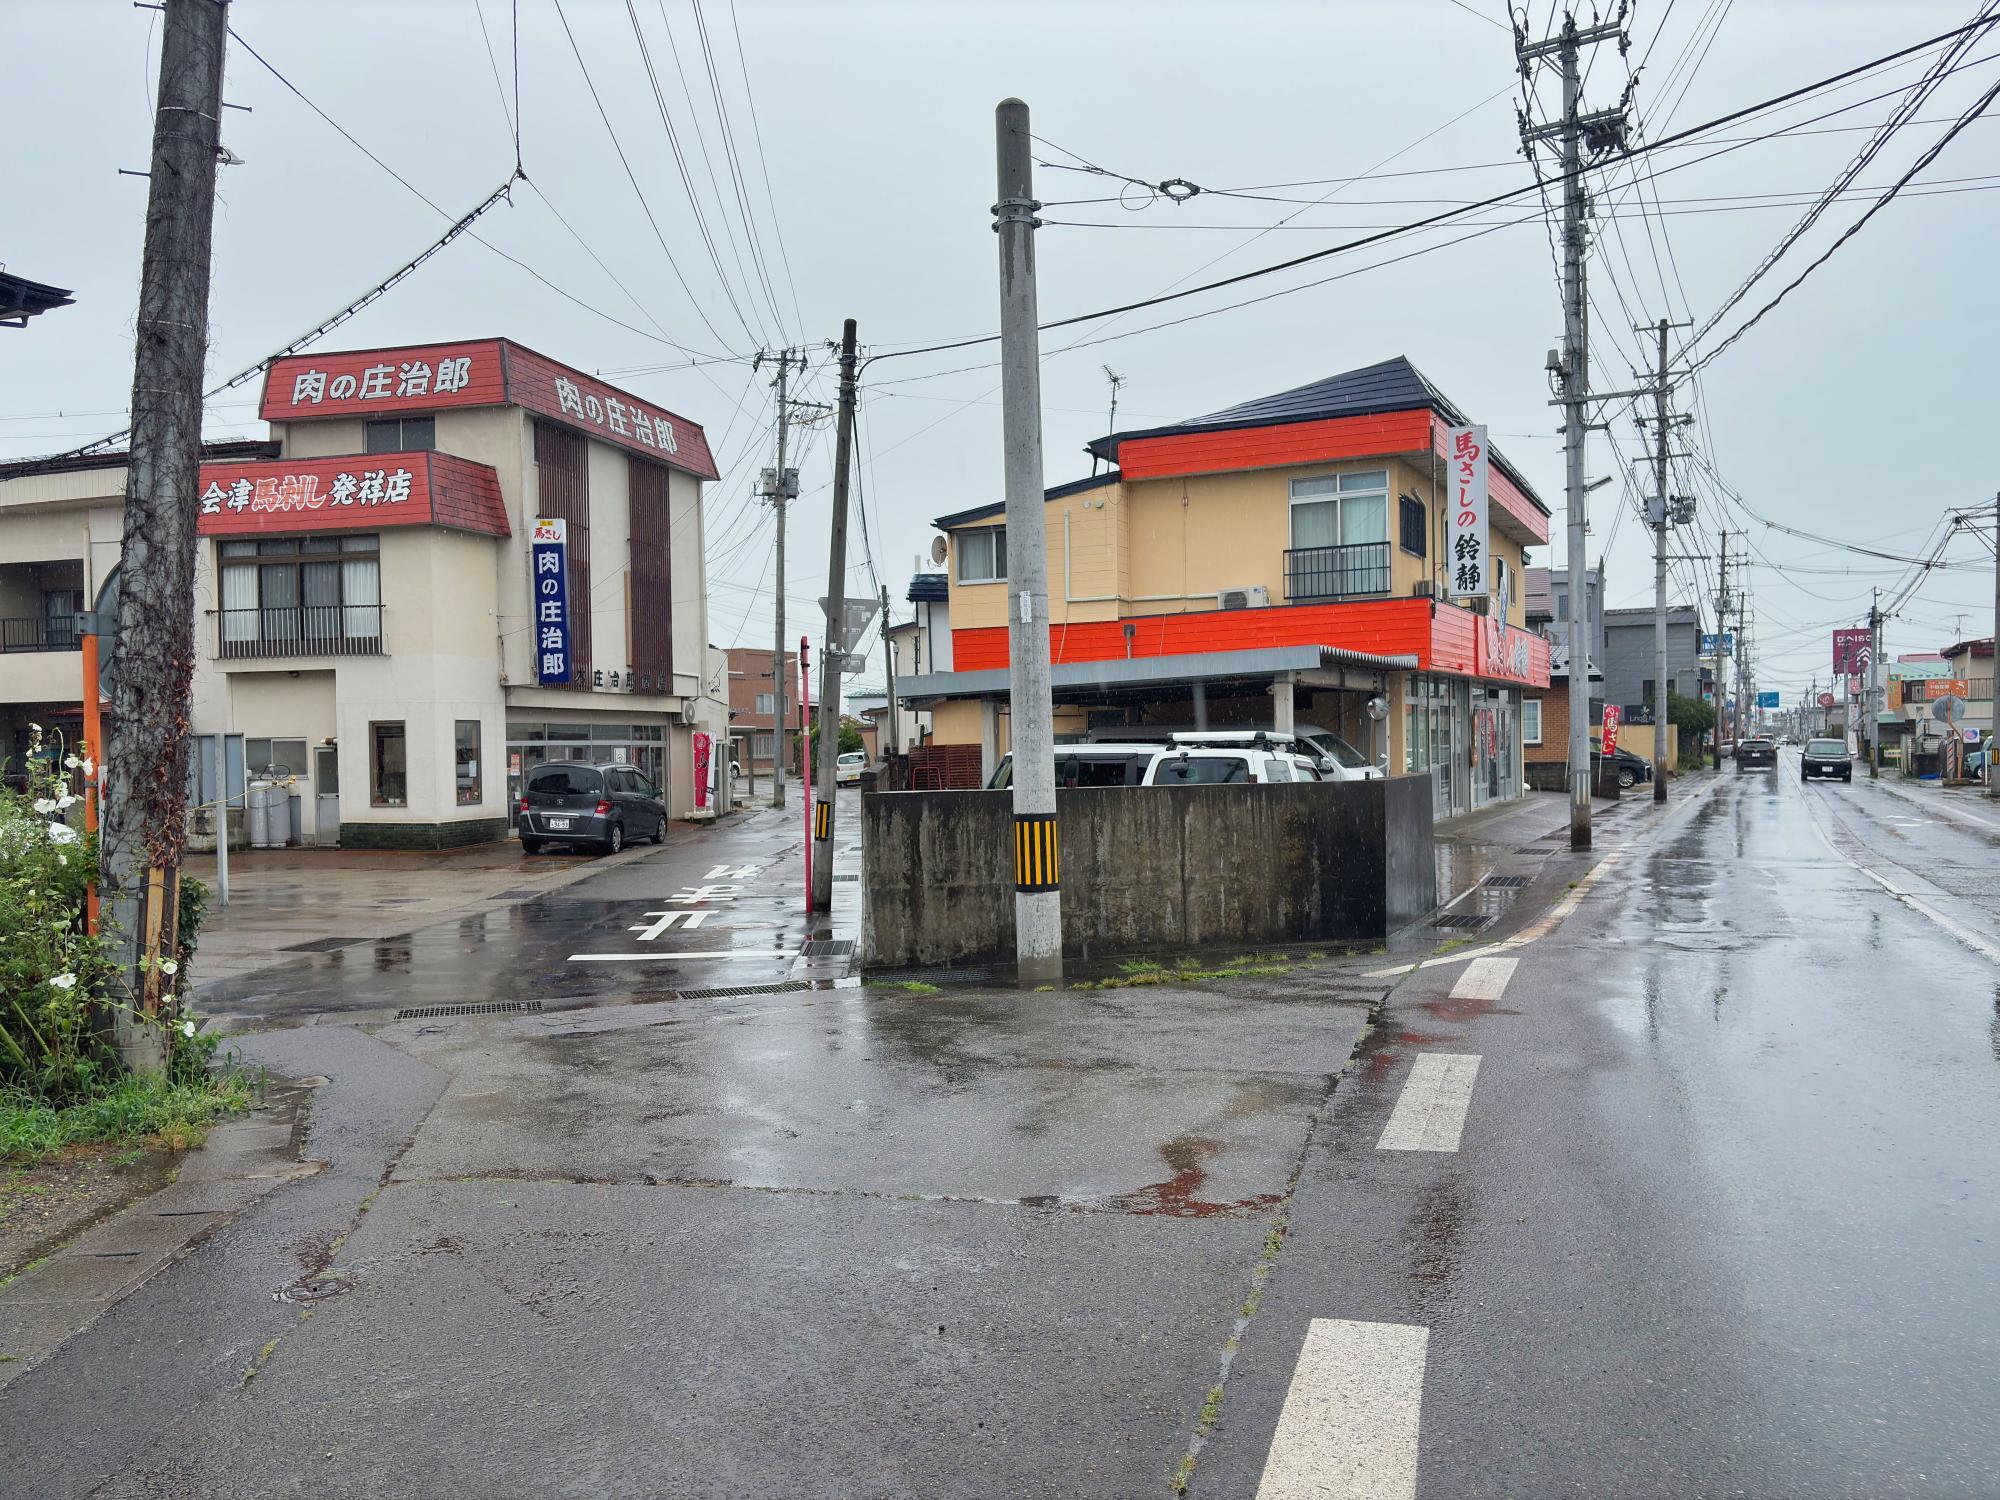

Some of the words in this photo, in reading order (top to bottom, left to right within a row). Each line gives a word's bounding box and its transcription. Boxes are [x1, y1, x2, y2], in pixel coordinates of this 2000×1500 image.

[291, 357, 472, 405] 肉の庄治郎
[555, 376, 678, 454] 肉の庄治郎
[200, 468, 412, 514] 会津馬刺し発祥店
[1453, 431, 1481, 591] 馬さしの鈴静
[534, 527, 561, 541] 馬さし
[538, 551, 565, 675] 肉の庄治郎
